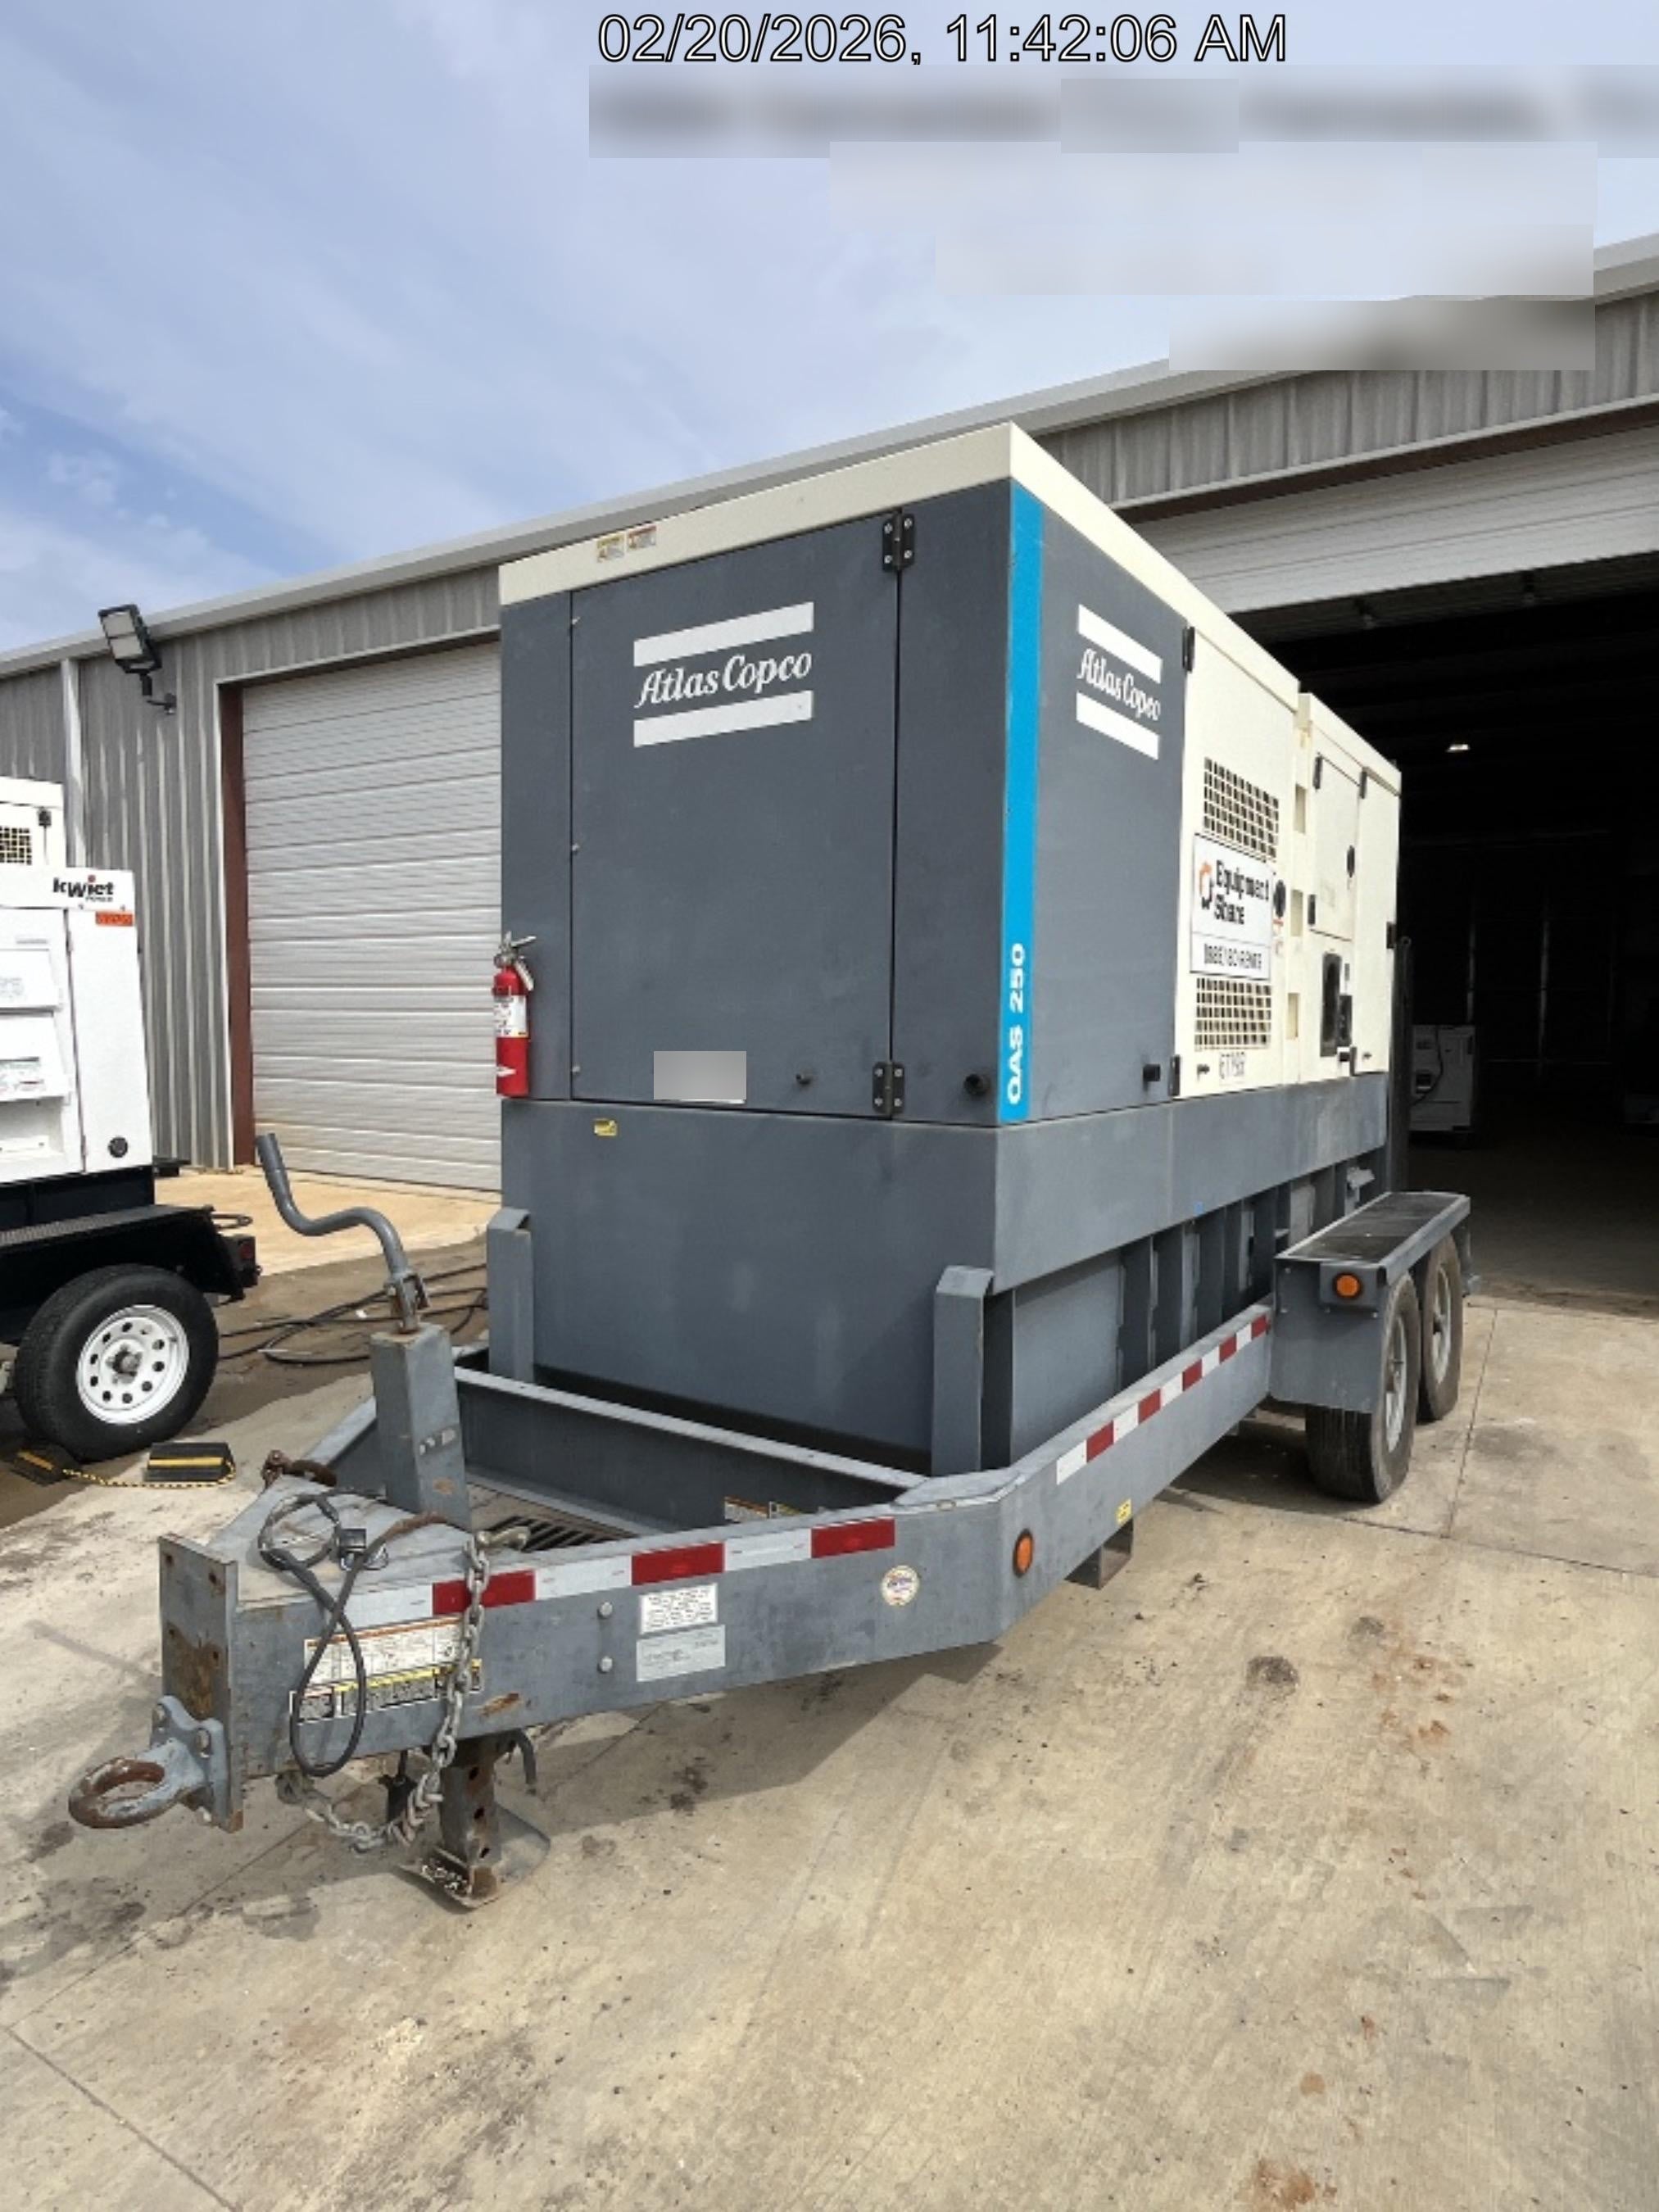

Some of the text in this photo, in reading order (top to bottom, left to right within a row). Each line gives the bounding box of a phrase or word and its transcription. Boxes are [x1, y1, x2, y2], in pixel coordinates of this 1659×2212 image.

[634, 652, 812, 708] Atlas Copco
[1077, 648, 1161, 721] Atlas Copco
[52, 874, 114, 897] kwiet
[1009, 942, 1026, 1014] 250
